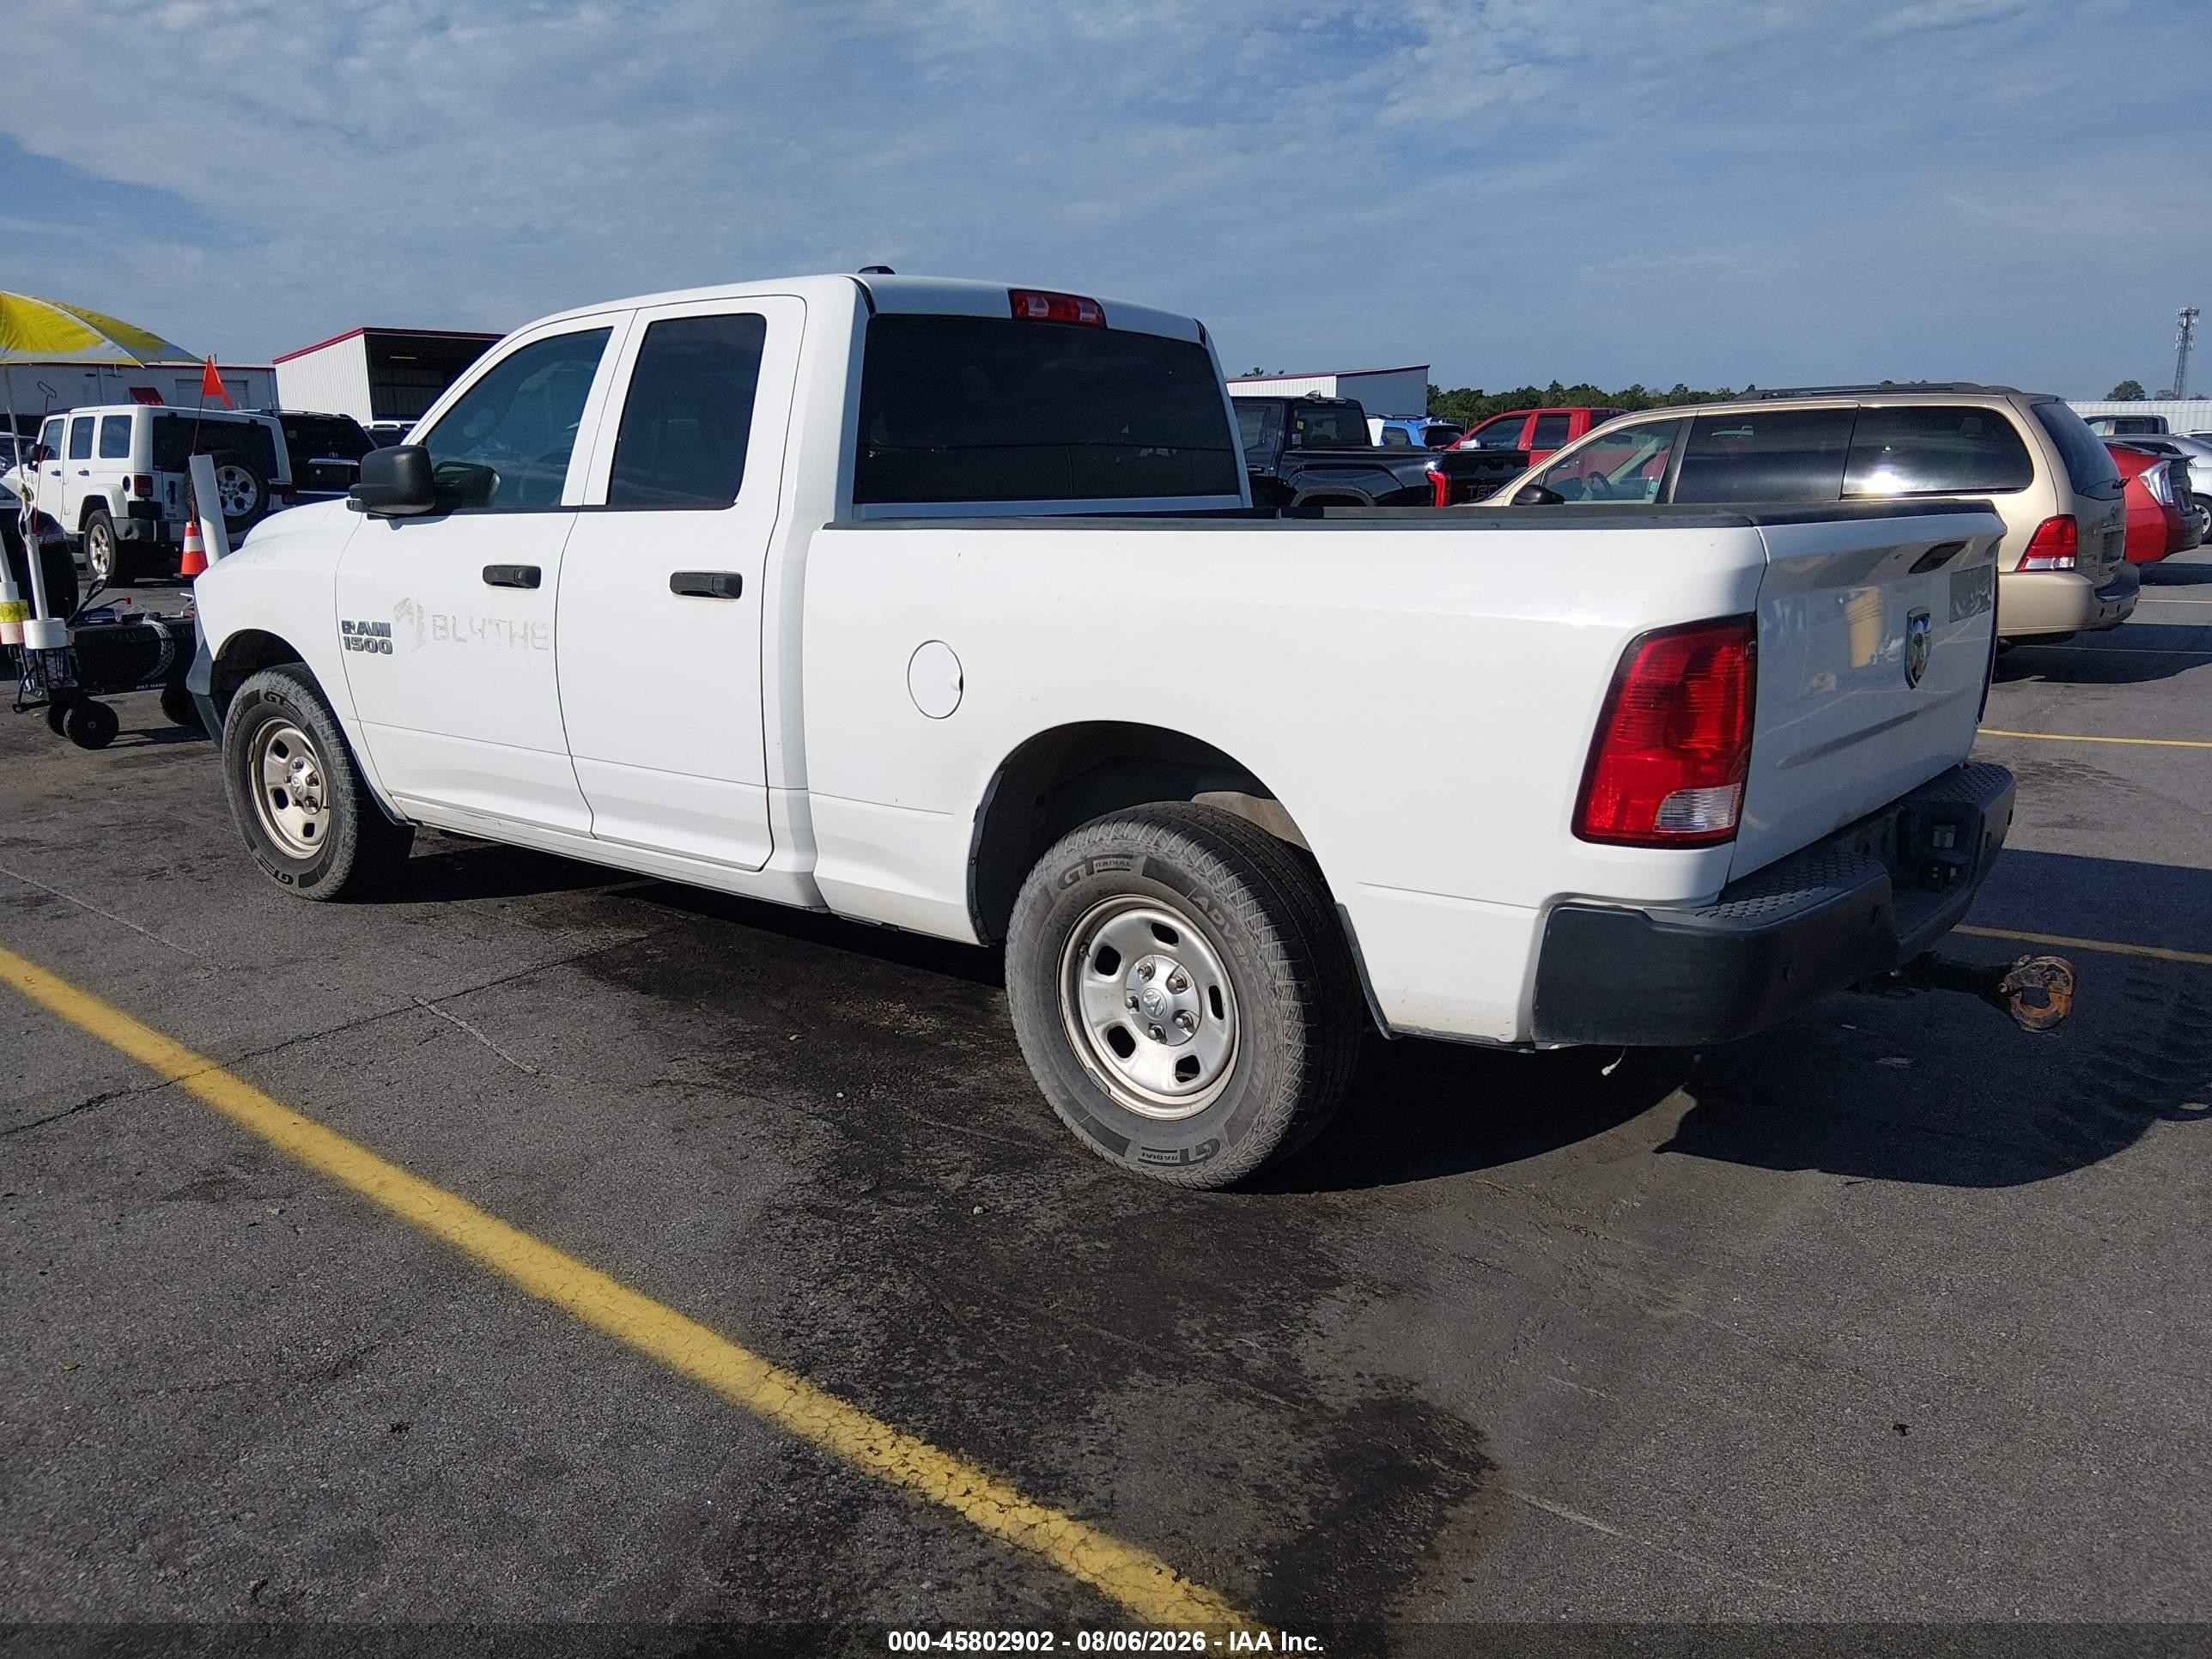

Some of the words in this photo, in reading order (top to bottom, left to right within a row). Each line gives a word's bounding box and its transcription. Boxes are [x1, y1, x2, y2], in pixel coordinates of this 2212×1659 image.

[341, 620, 392, 637] RAM
[343, 636, 392, 655] 1500
[1142, 1152, 1178, 1161] RADIAL
